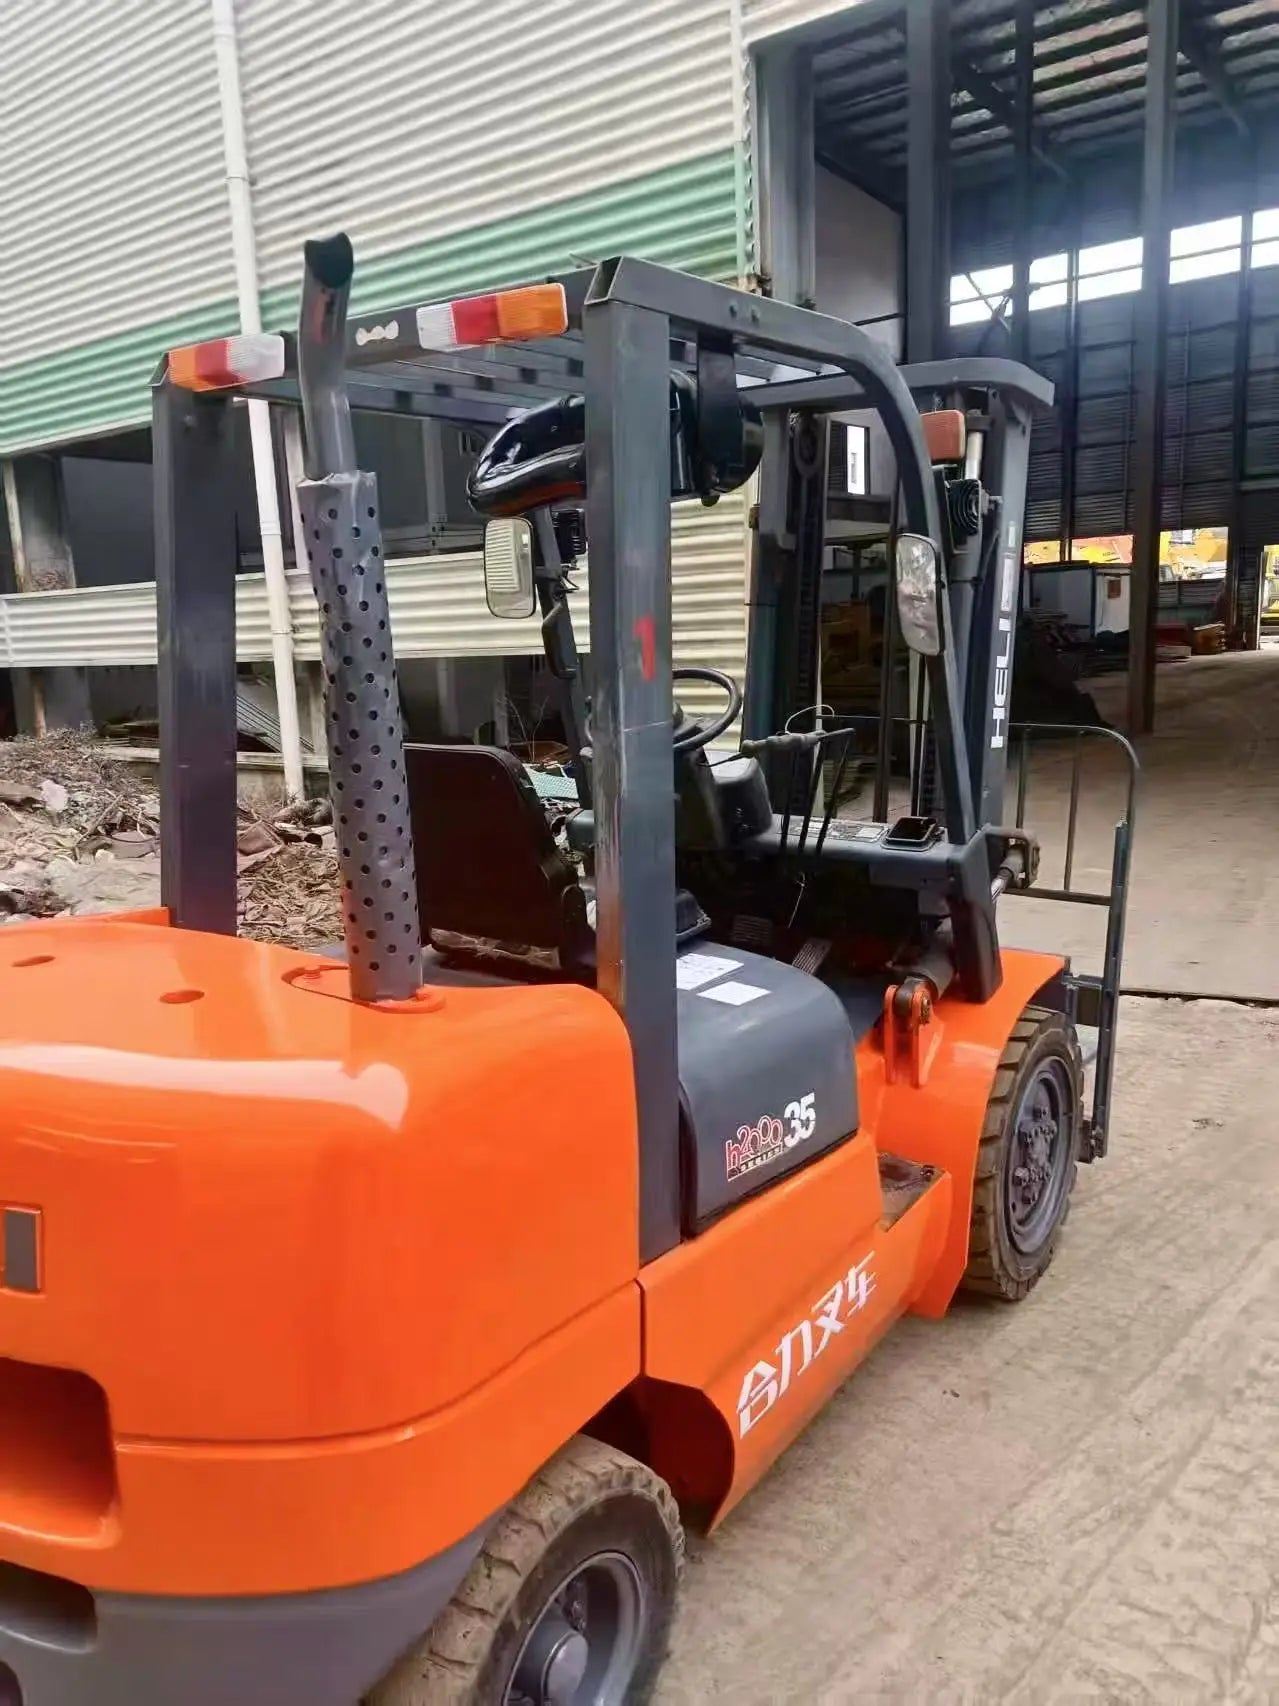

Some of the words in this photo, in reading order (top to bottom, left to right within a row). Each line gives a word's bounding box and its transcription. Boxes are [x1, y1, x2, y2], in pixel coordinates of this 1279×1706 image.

[991, 618, 1011, 748] HELI
[726, 1115, 783, 1171] h2000
[784, 1092, 816, 1148] 35
[736, 1251, 876, 1439] 合力叉车
